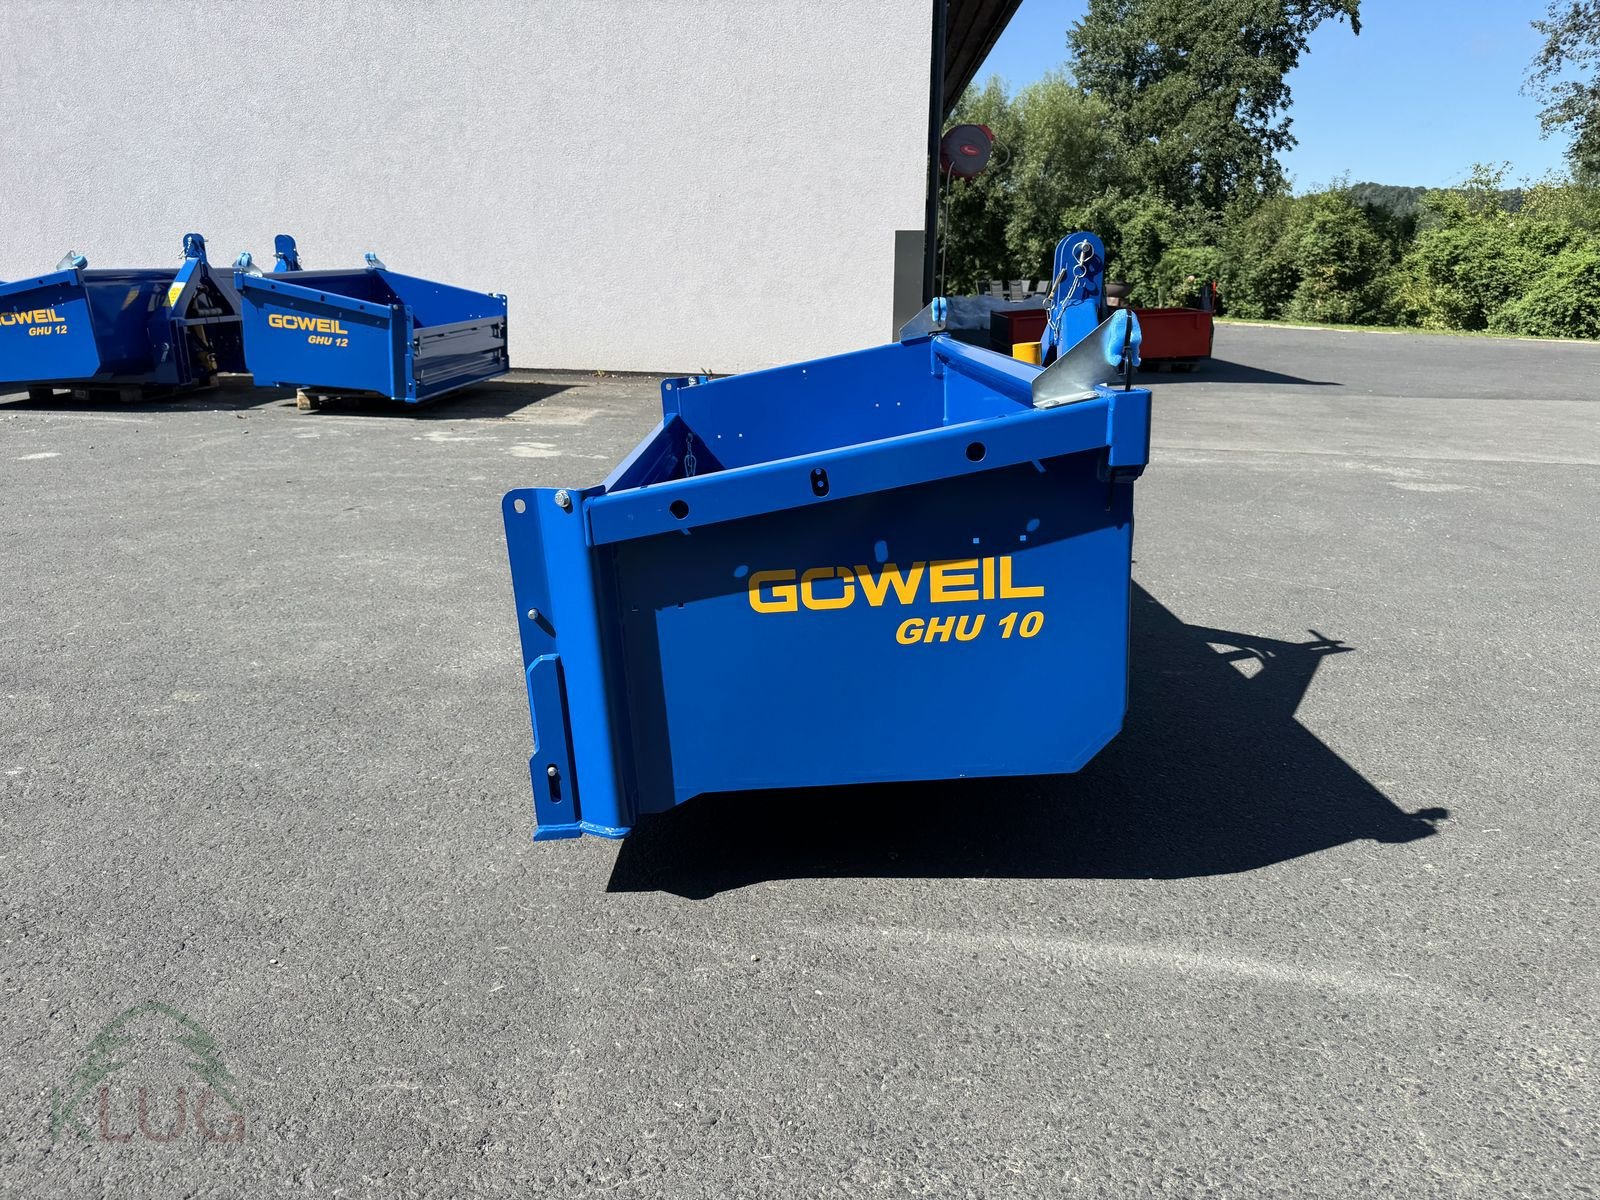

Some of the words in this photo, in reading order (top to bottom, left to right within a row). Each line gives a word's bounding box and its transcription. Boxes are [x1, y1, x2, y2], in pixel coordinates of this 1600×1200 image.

[29, 326, 52, 337] GHU
[55, 324, 68, 335] 12
[308, 335, 334, 346] GHU
[335, 337, 349, 348] 12
[895, 614, 986, 645] GHU
[998, 611, 1045, 639] 10
